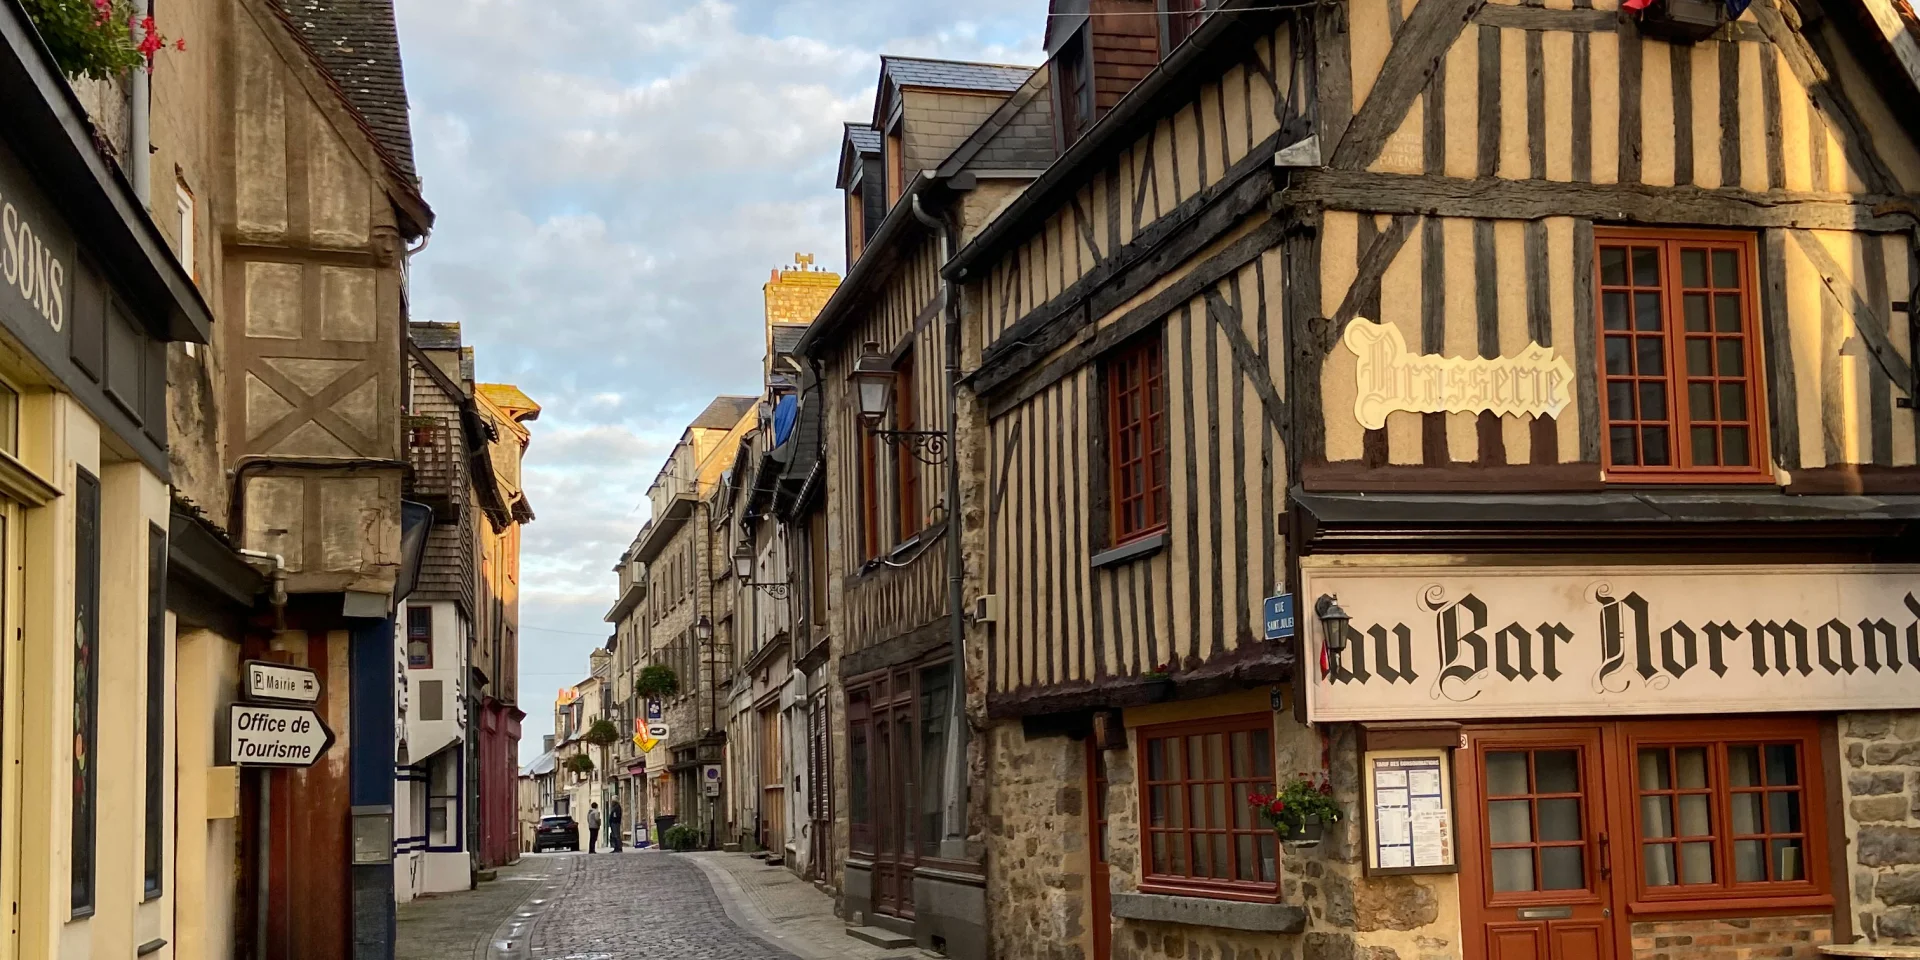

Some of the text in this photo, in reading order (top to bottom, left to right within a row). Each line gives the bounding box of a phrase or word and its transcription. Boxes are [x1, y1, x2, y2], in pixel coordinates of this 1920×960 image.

[0, 193, 63, 332] SONS
[1350, 325, 1564, 427] Brasserie
[1274, 601, 1285, 614] RUE
[1416, 582, 1575, 702] Bar
[266, 675, 296, 691] Mairie
[237, 712, 310, 733] Office de
[237, 738, 311, 758] Tourisme
